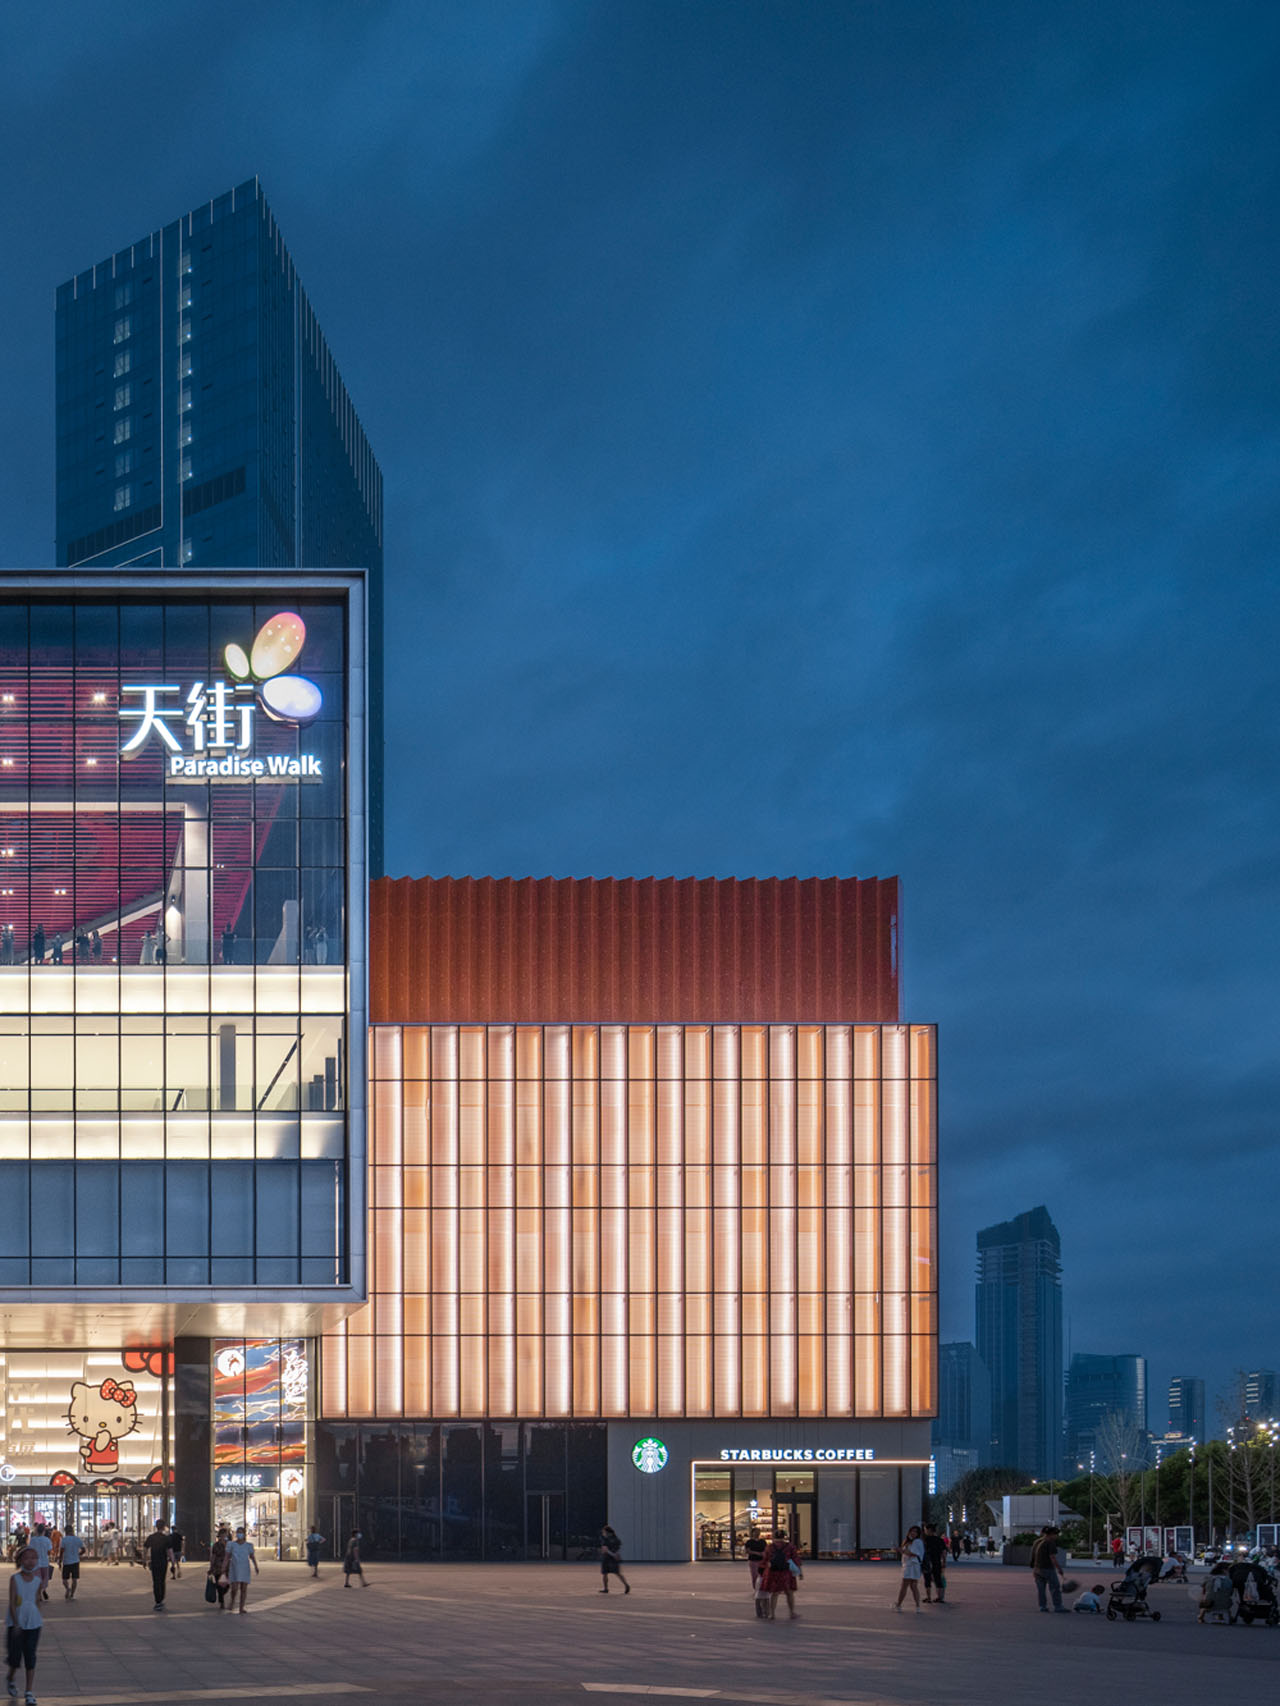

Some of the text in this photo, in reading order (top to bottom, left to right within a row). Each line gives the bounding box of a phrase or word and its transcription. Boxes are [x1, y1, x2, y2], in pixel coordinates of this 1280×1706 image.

[119, 682, 255, 751] 天街
[171, 755, 321, 776] Paradise Walk
[720, 1450, 874, 1460] STARBUCKS COFFEE
